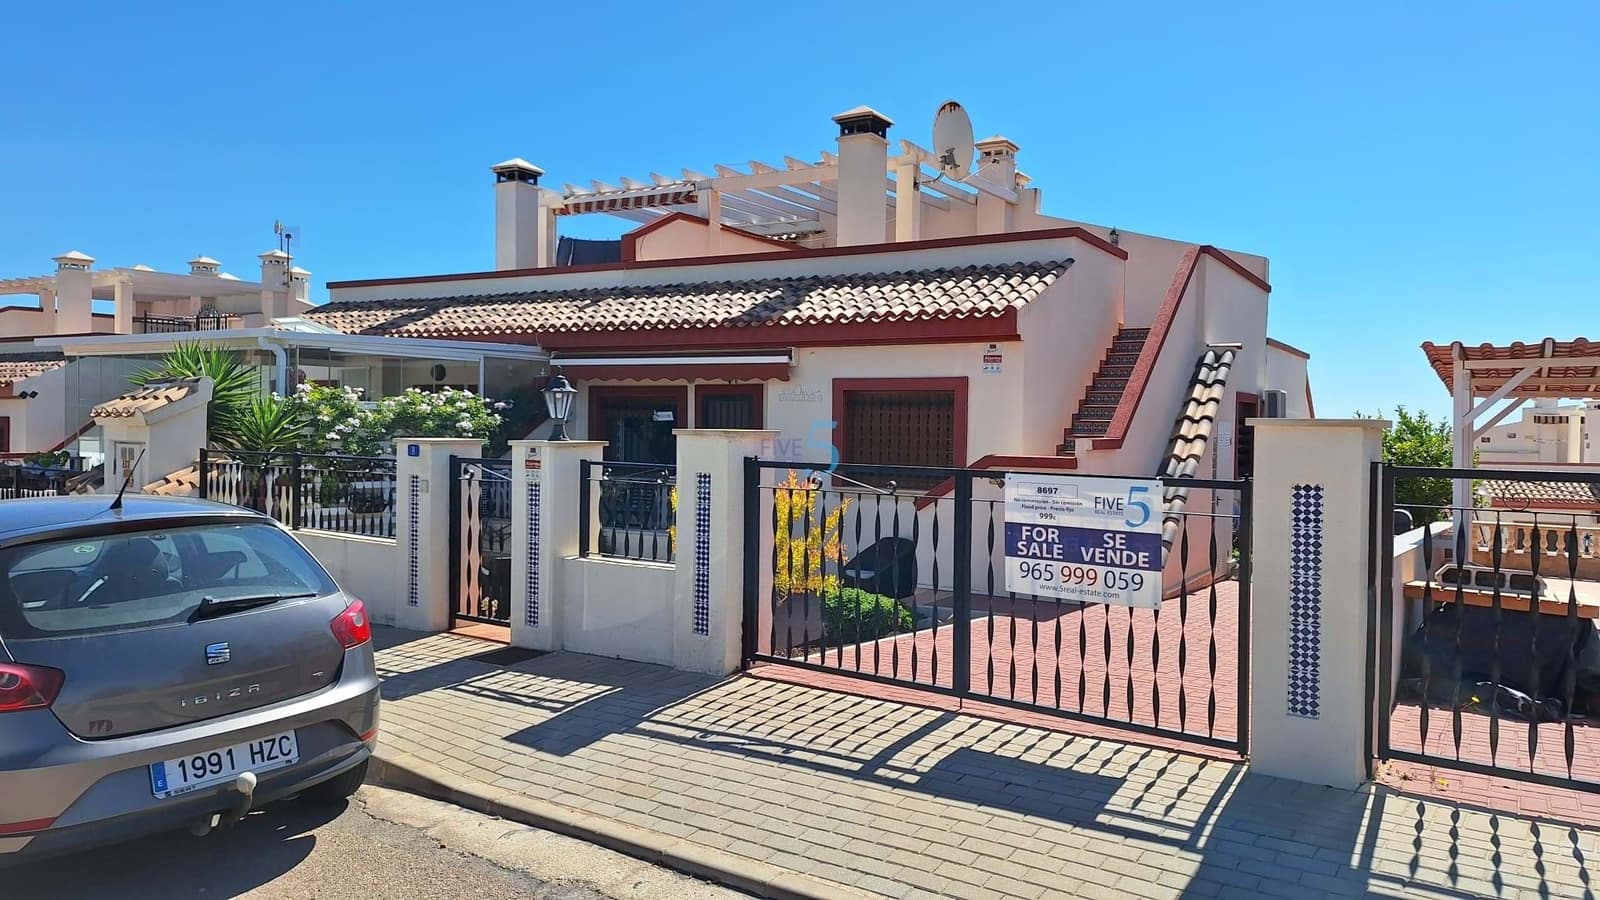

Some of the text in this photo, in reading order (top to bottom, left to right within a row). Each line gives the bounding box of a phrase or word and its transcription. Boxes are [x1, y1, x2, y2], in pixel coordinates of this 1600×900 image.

[1037, 486, 1058, 495] 8697
[1094, 486, 1150, 528] FIVE 5
[1021, 526, 1059, 543] FOR
[1103, 533, 1126, 549] SE
[1017, 541, 1064, 560] SALE
[1080, 546, 1150, 568] VENDE
[1019, 561, 1144, 592] 965 999 059
[1039, 583, 1120, 600] www.5real-estate.com
[177, 735, 293, 783] 1991 HZC
